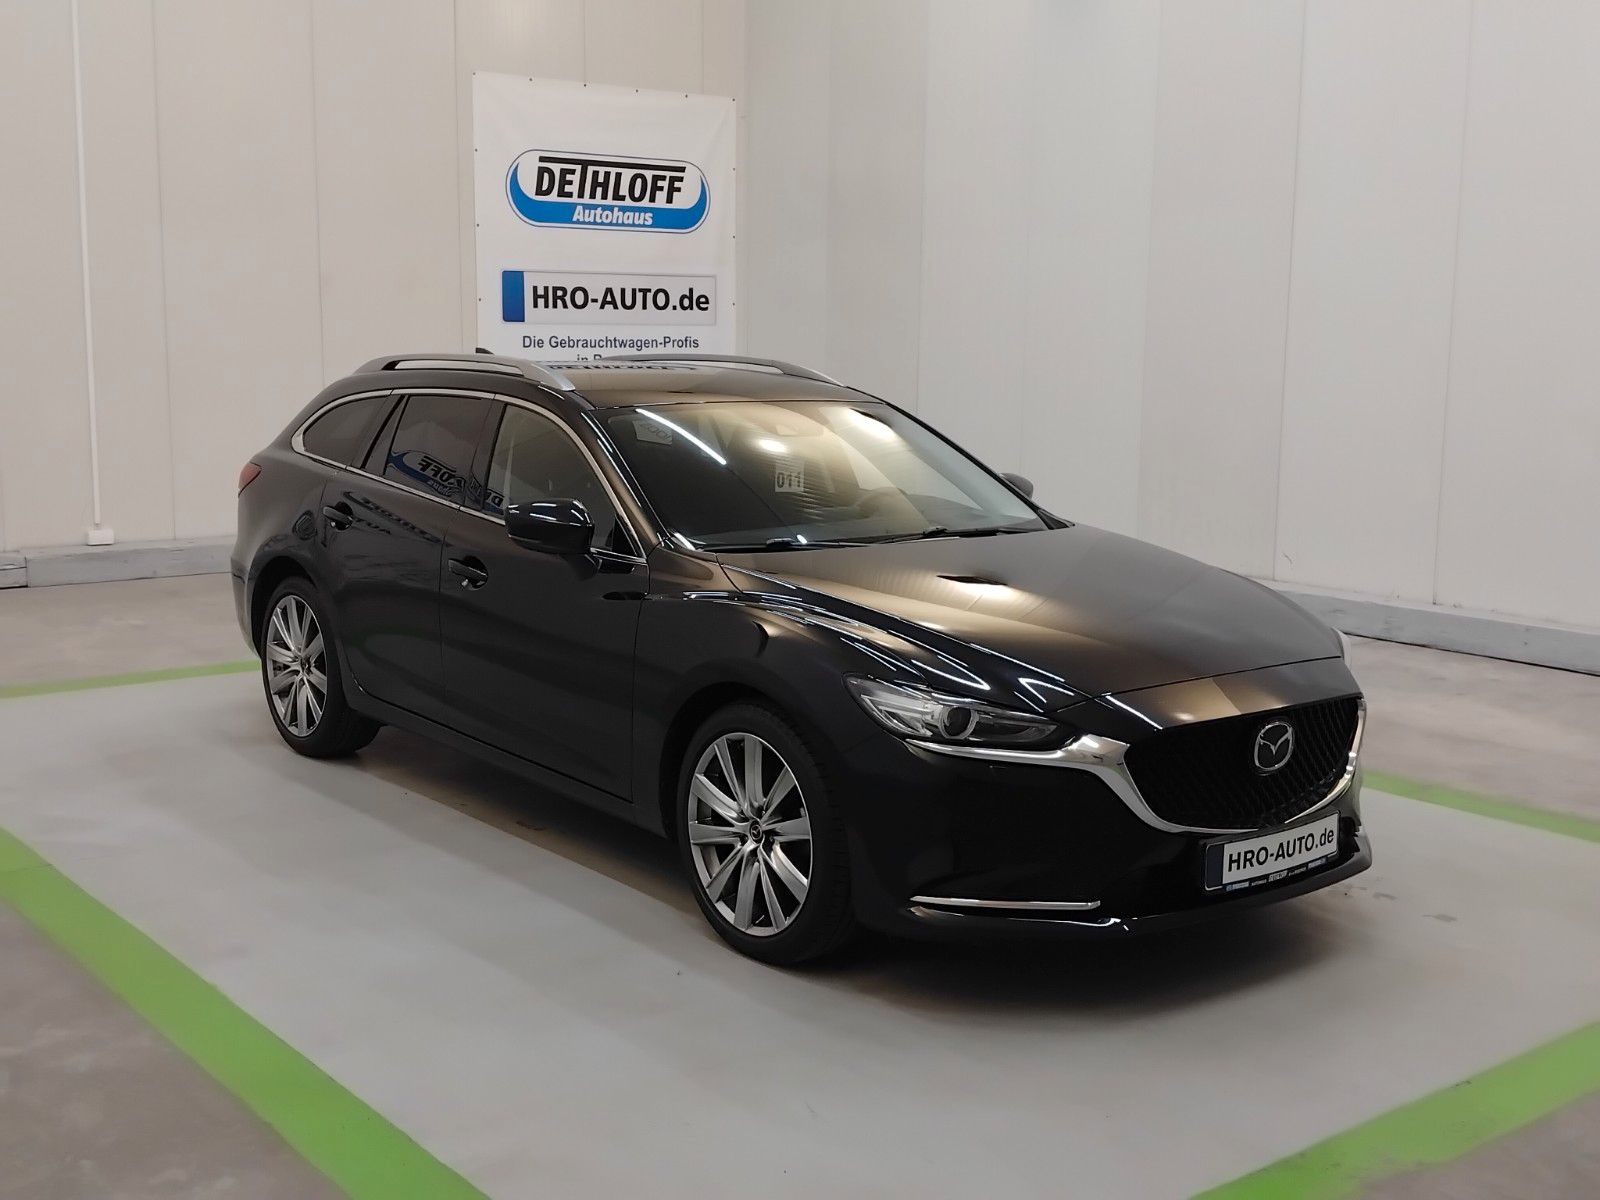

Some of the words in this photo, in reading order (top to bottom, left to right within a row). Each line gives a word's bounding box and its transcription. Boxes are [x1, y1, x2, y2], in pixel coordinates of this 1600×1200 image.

[535, 156, 686, 204] DETHLOFF
[572, 206, 653, 225] Autohaus
[532, 286, 710, 311] HRO-AUTO.de
[522, 336, 544, 348] Die
[549, 335, 700, 351] Gebrauchtwagen-Profis
[776, 471, 801, 488] 011
[1227, 828, 1335, 872] HRO-AUTO.de
